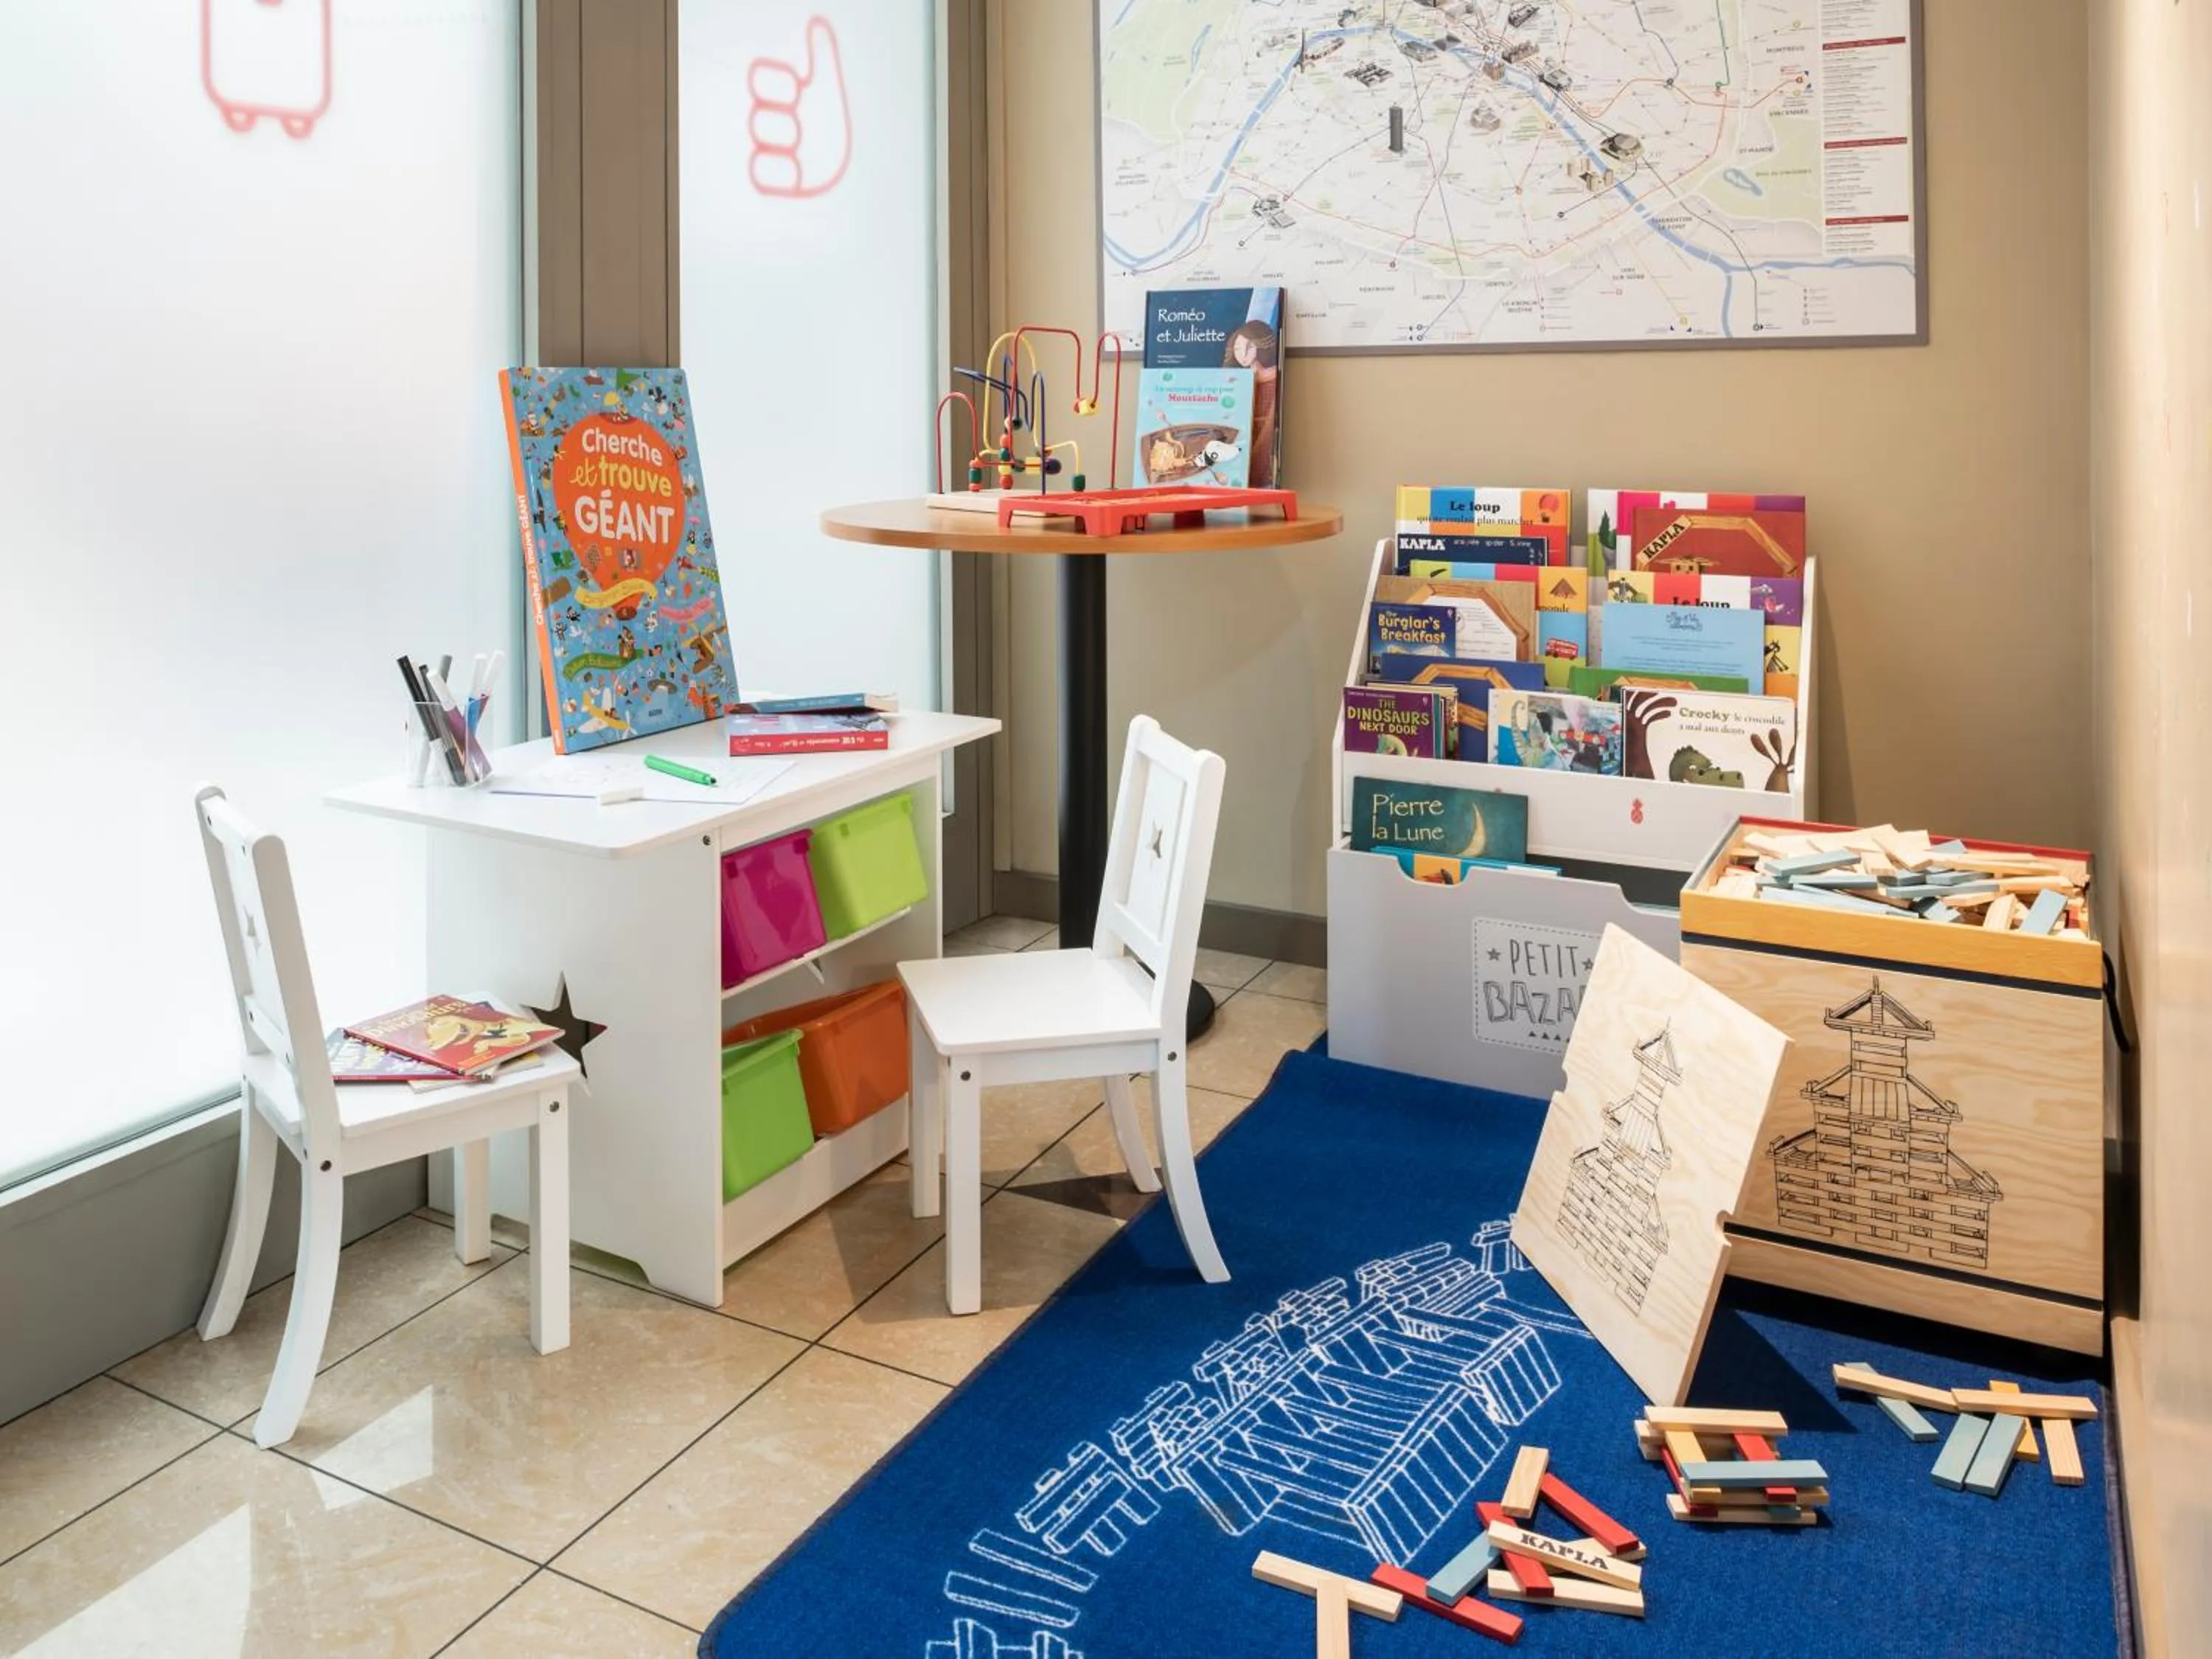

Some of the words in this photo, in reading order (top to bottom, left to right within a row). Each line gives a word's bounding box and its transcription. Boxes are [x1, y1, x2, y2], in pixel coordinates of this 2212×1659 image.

[1158, 308, 1206, 323] Roméo
[1156, 330, 1171, 343] et
[1173, 324, 1225, 343] Juliette
[1168, 392, 1219, 402] Moustache
[581, 428, 663, 466] Cherche
[569, 457, 598, 487] et
[598, 455, 672, 497] trouve
[1450, 501, 1464, 511] Le
[1469, 501, 1500, 515] loup
[574, 489, 675, 546] GÉANT
[1477, 516, 1495, 526] plus
[1399, 538, 1446, 551] KAPLA
[1643, 522, 1686, 560] KAPLA
[1378, 613, 1440, 630] Burglar's
[1381, 627, 1446, 644] Breakfast
[1378, 699, 1397, 709] THE
[1347, 706, 1430, 726] DINOSAURS
[1679, 707, 1730, 722] Crocky
[1733, 712, 1741, 721] le
[1744, 715, 1785, 725] crocodile
[1359, 721, 1385, 732] NEXT
[1389, 724, 1419, 735] DOOR
[1372, 793, 1446, 816] Pierre
[1372, 814, 1388, 840] la
[1395, 824, 1446, 842] Lune
[1509, 939, 1579, 978] PETIT
[1520, 1533, 1610, 1571] KAPLA
